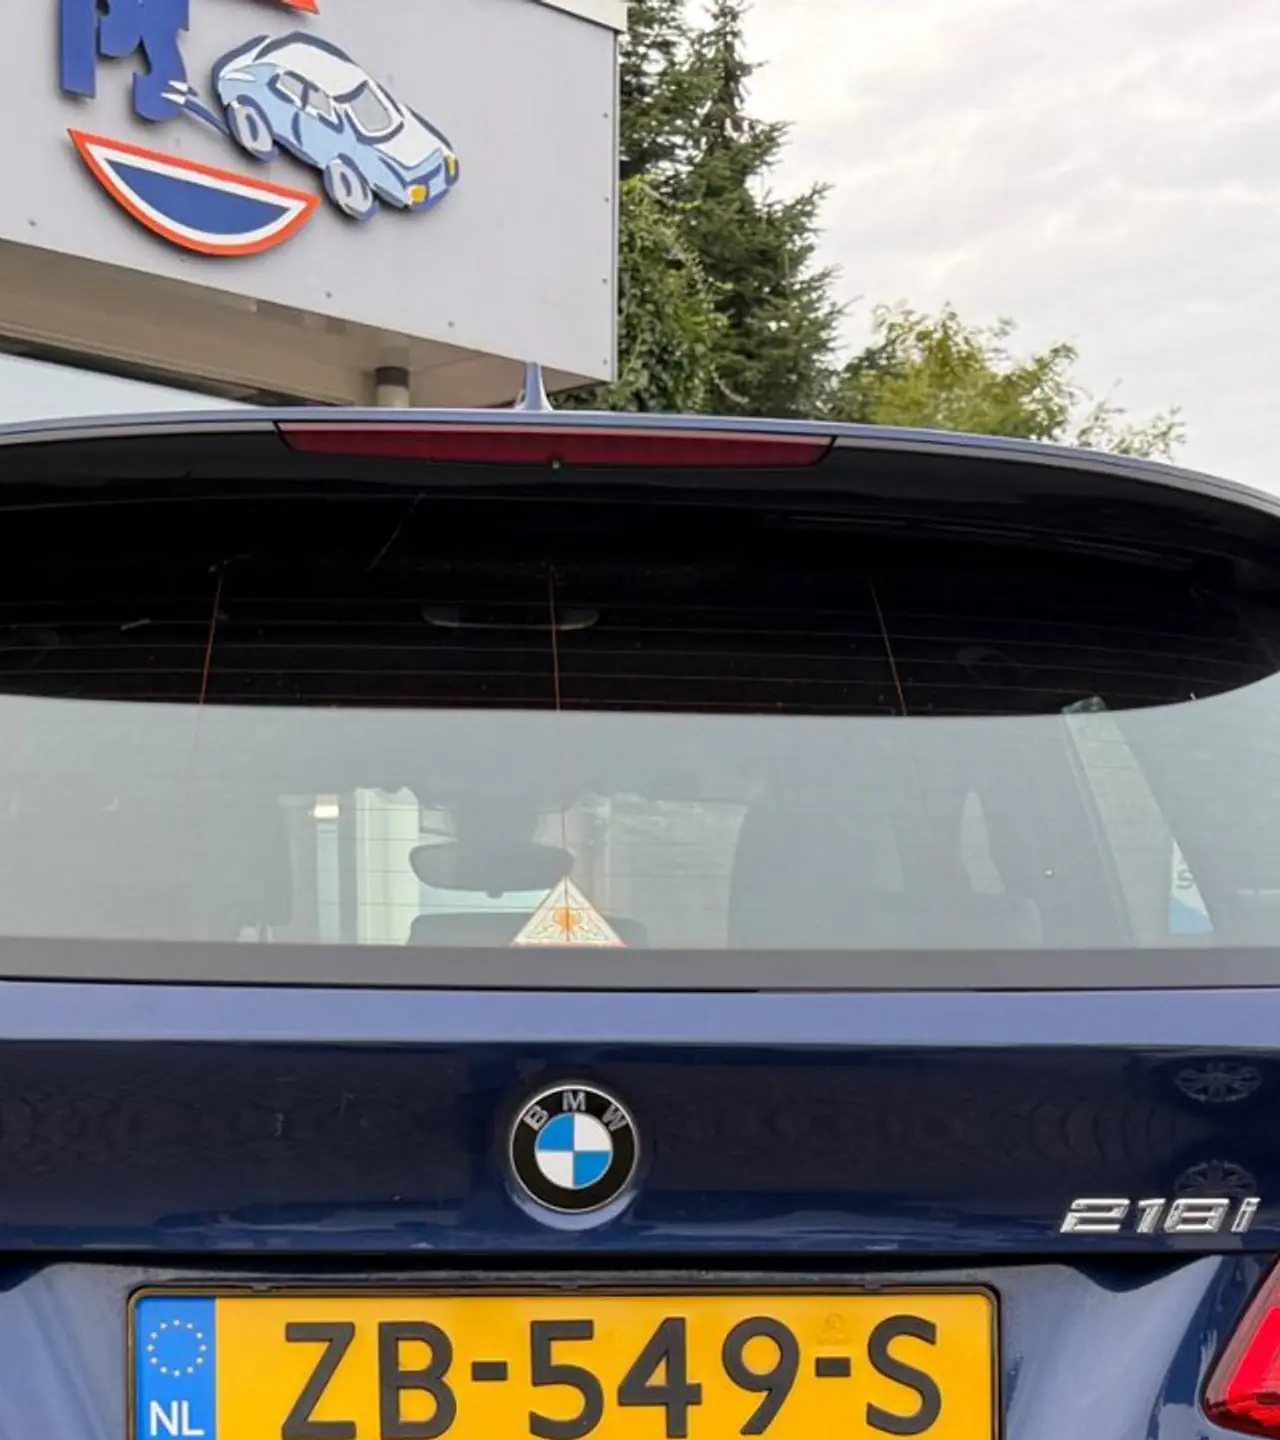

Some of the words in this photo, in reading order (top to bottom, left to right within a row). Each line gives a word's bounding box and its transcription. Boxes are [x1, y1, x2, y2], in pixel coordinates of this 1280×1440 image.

[523, 1091, 628, 1132] BMW
[1060, 1197, 1261, 1233] 218i
[149, 1399, 206, 1437] NL
